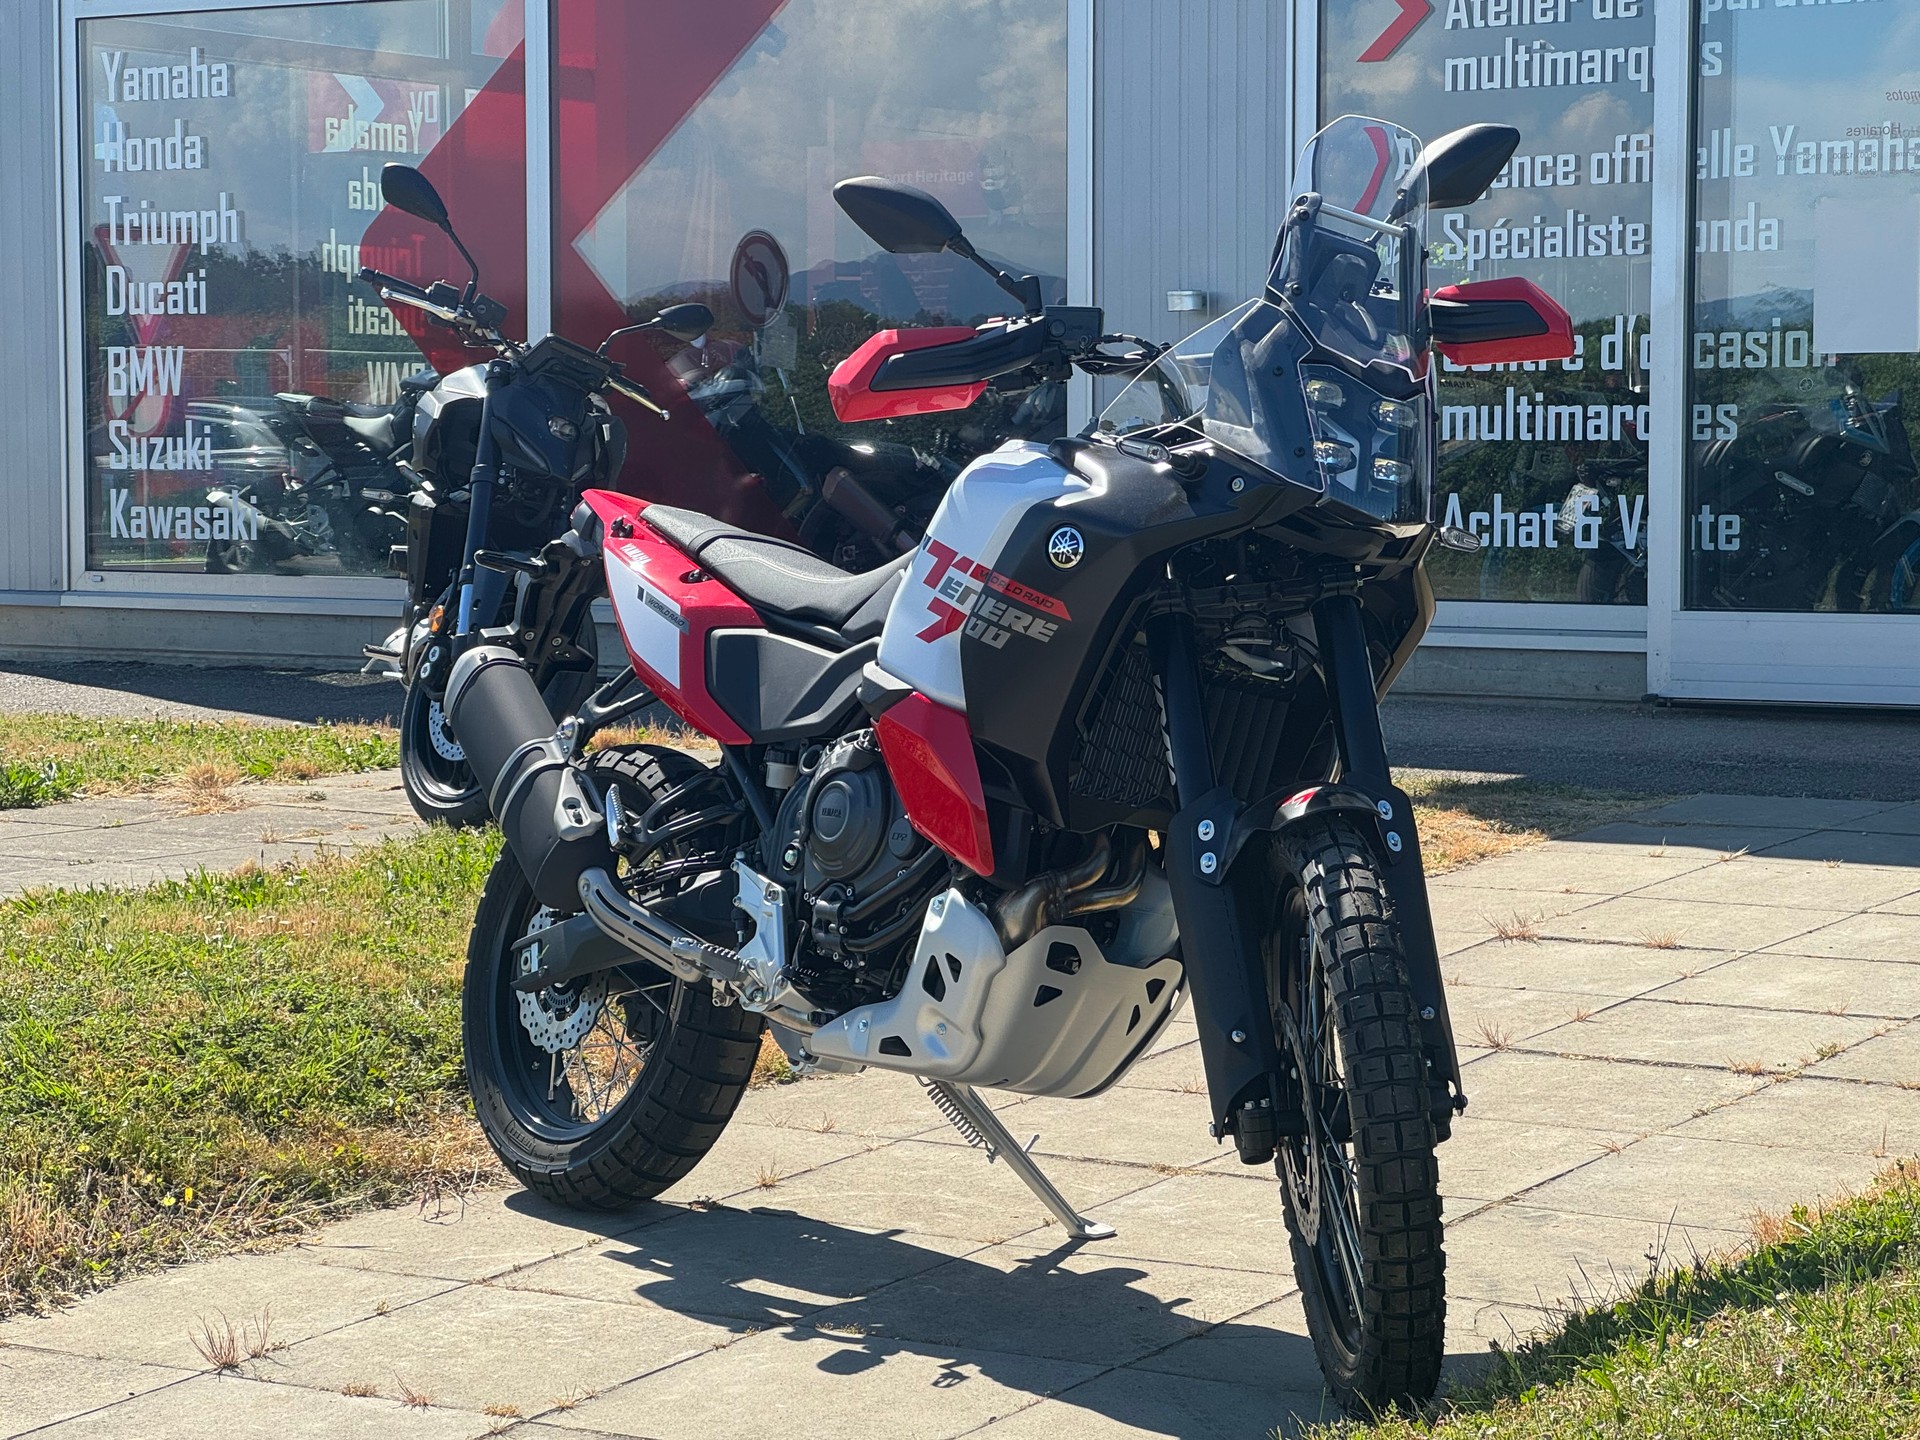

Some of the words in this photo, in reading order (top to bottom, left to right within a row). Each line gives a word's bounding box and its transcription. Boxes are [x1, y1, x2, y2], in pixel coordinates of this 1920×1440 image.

[100, 47, 228, 103] Yamaha
[1444, 36, 1722, 92] multimarqs
[103, 118, 201, 172] Honda
[1590, 127, 1754, 185] offielle
[1769, 121, 1920, 175] Yamaha
[103, 192, 239, 256] Triumph
[1443, 208, 1645, 271] Spécialiste
[1695, 201, 1779, 253] onda
[106, 266, 207, 316] Ducati
[1600, 314, 1837, 370] d'casio
[107, 346, 184, 397] BMW
[1442, 386, 1738, 441] multimares
[109, 420, 212, 471] Suzuki
[109, 489, 258, 541] Kawasaki
[1444, 493, 1558, 548] Achat
[1574, 494, 1602, 549] &
[1617, 494, 1740, 550] Vte
[648, 596, 671, 619] WORLD
[669, 612, 685, 628] RAID
[979, 567, 1023, 598] WORLD
[1023, 591, 1055, 610] RAID
